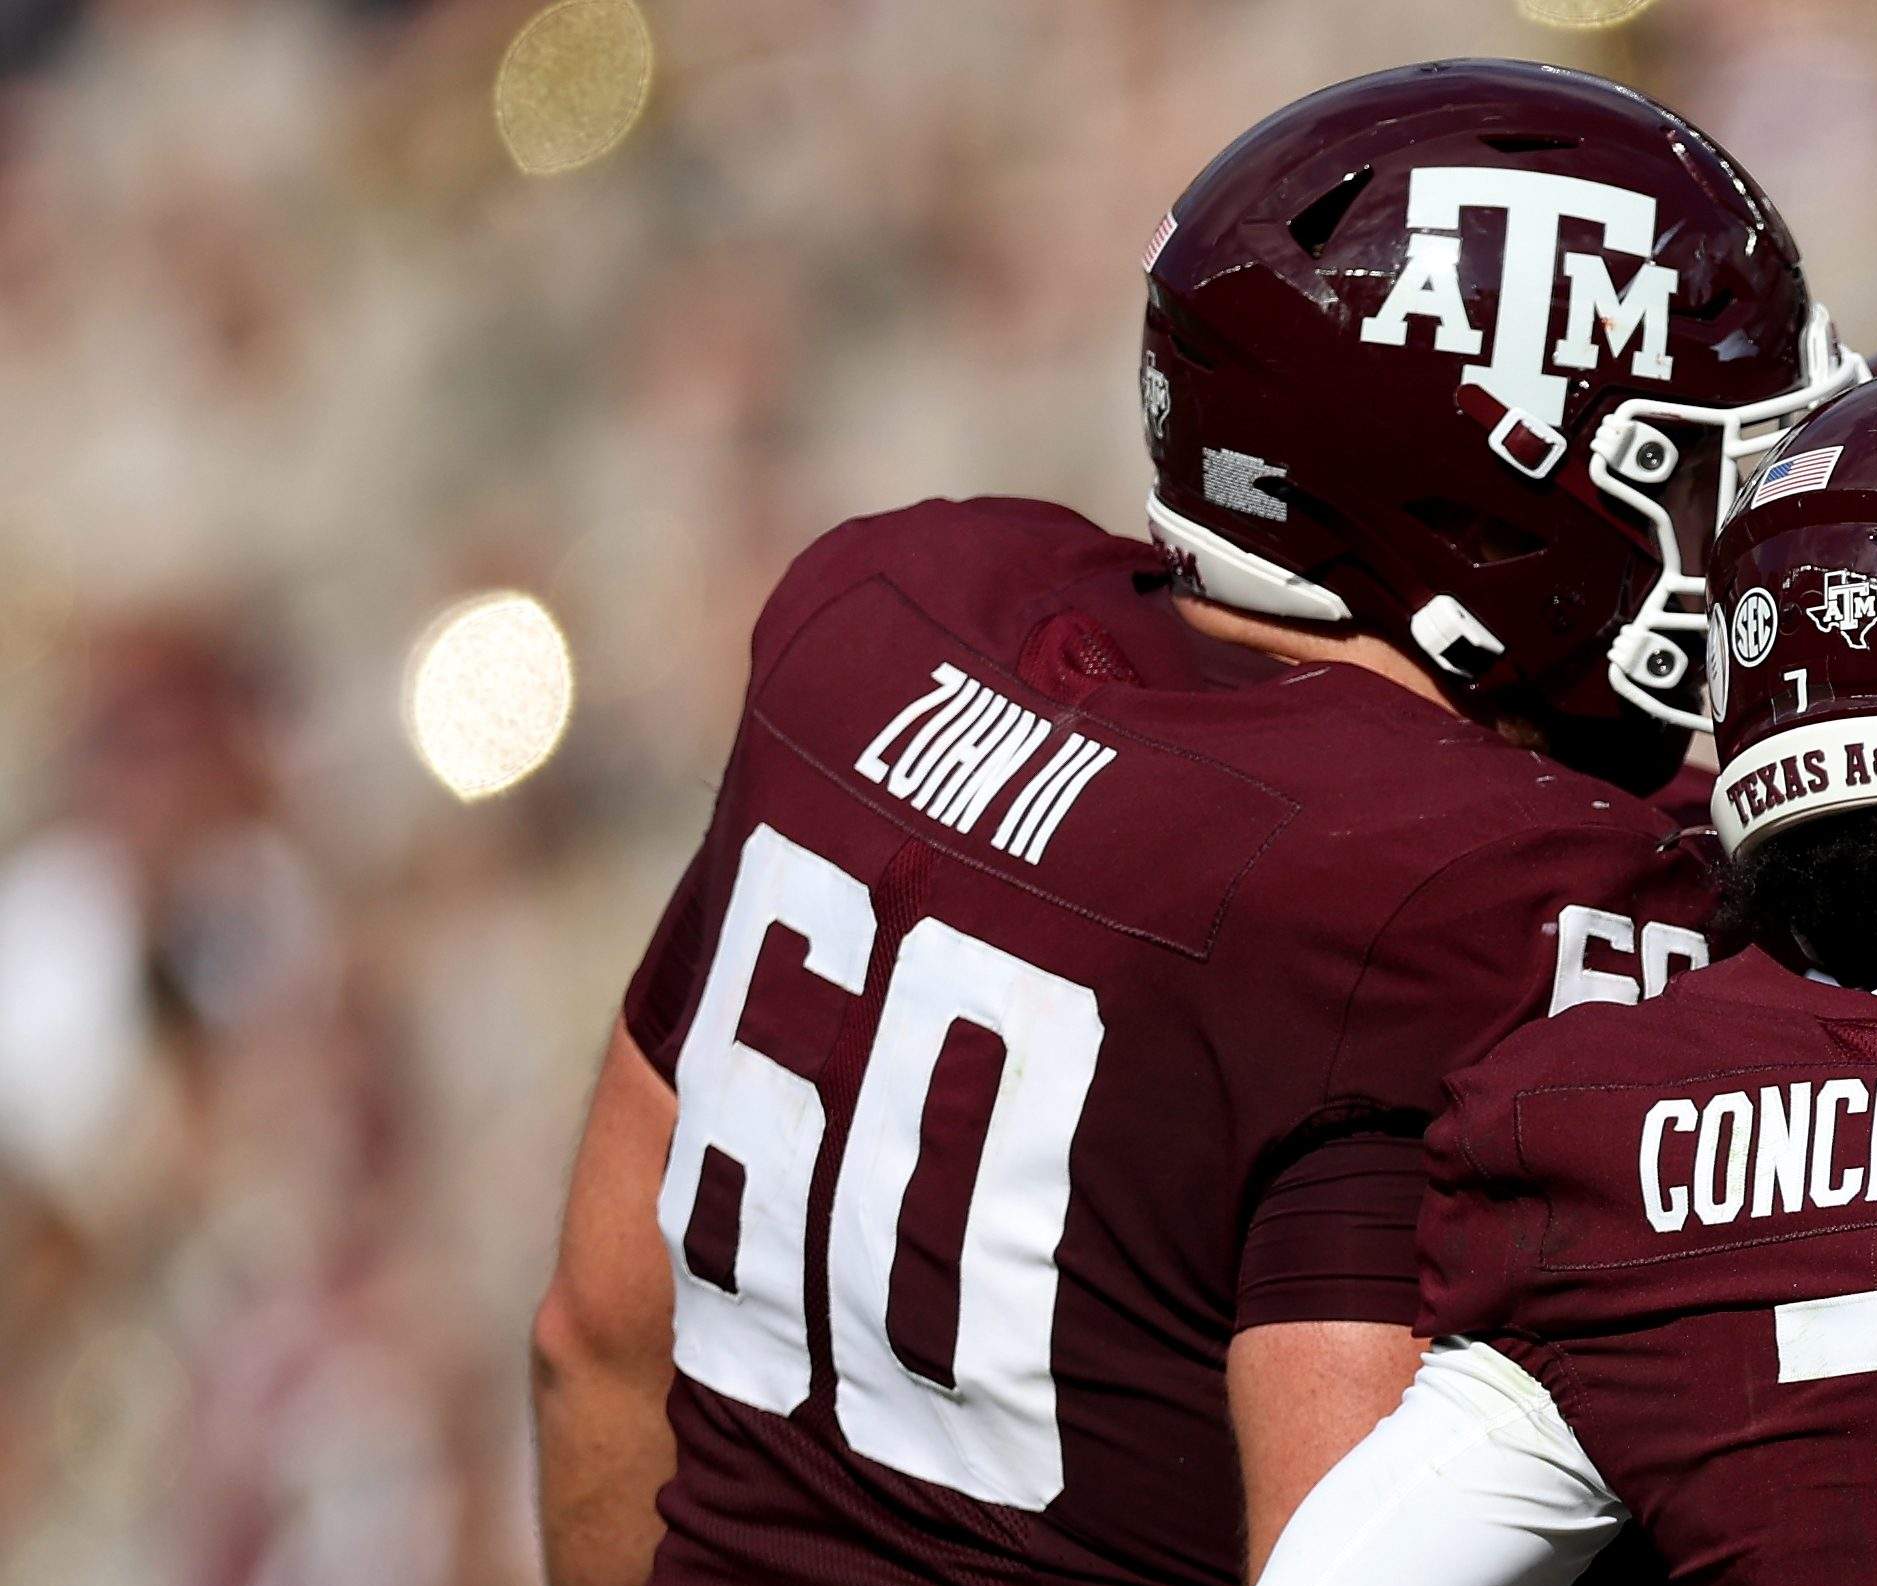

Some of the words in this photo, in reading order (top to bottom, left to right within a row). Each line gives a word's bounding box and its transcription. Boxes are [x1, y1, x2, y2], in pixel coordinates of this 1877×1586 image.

[1736, 596, 1771, 658] SEC
[1784, 669, 1808, 713] 7
[855, 662, 1052, 834] ZUHN
[991, 731, 1117, 866] III
[1726, 749, 1829, 828] TEXAS
[657, 822, 1105, 1513] 60
